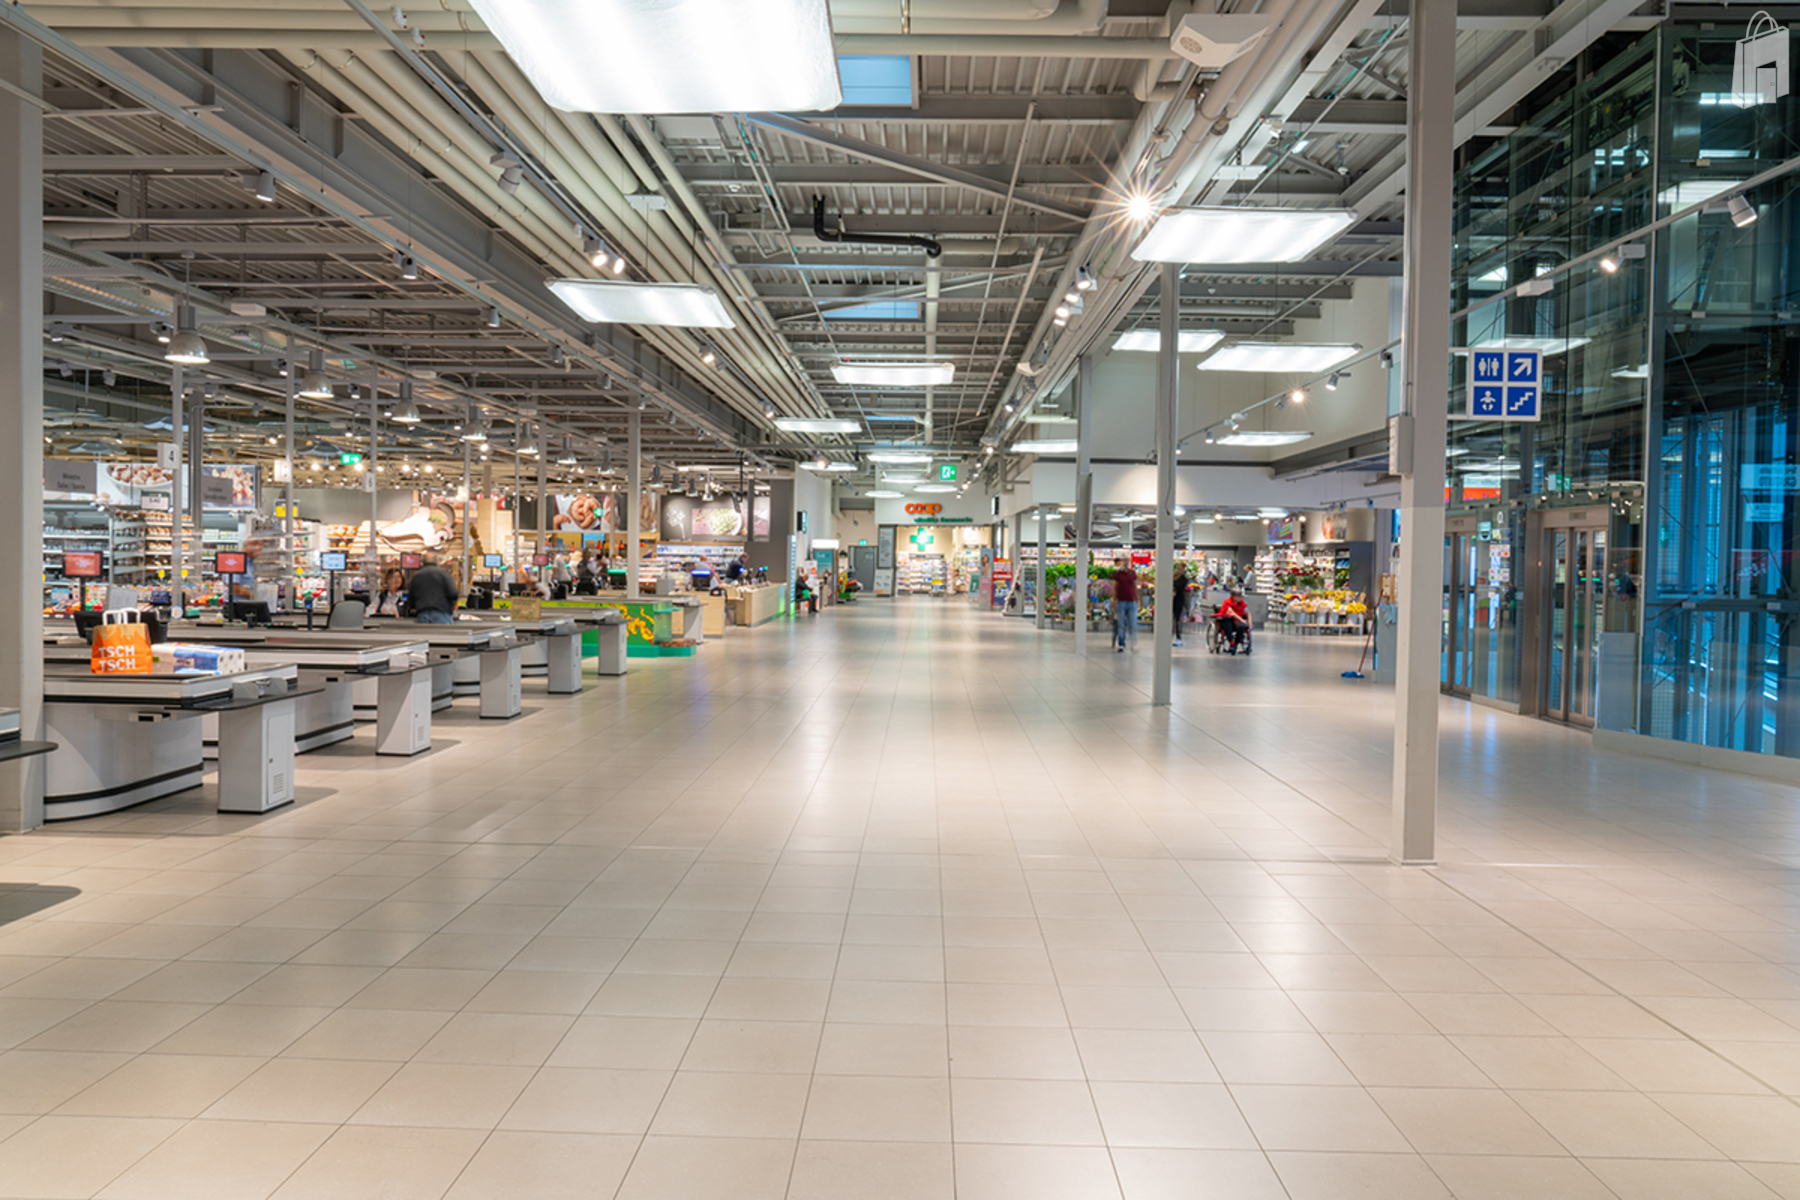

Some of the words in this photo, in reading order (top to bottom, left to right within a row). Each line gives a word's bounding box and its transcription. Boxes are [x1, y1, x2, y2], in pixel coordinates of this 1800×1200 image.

[168, 450, 174, 462] 4
[904, 503, 941, 516] coop
[98, 645, 135, 658] TSCH
[99, 658, 136, 671] TSCH
